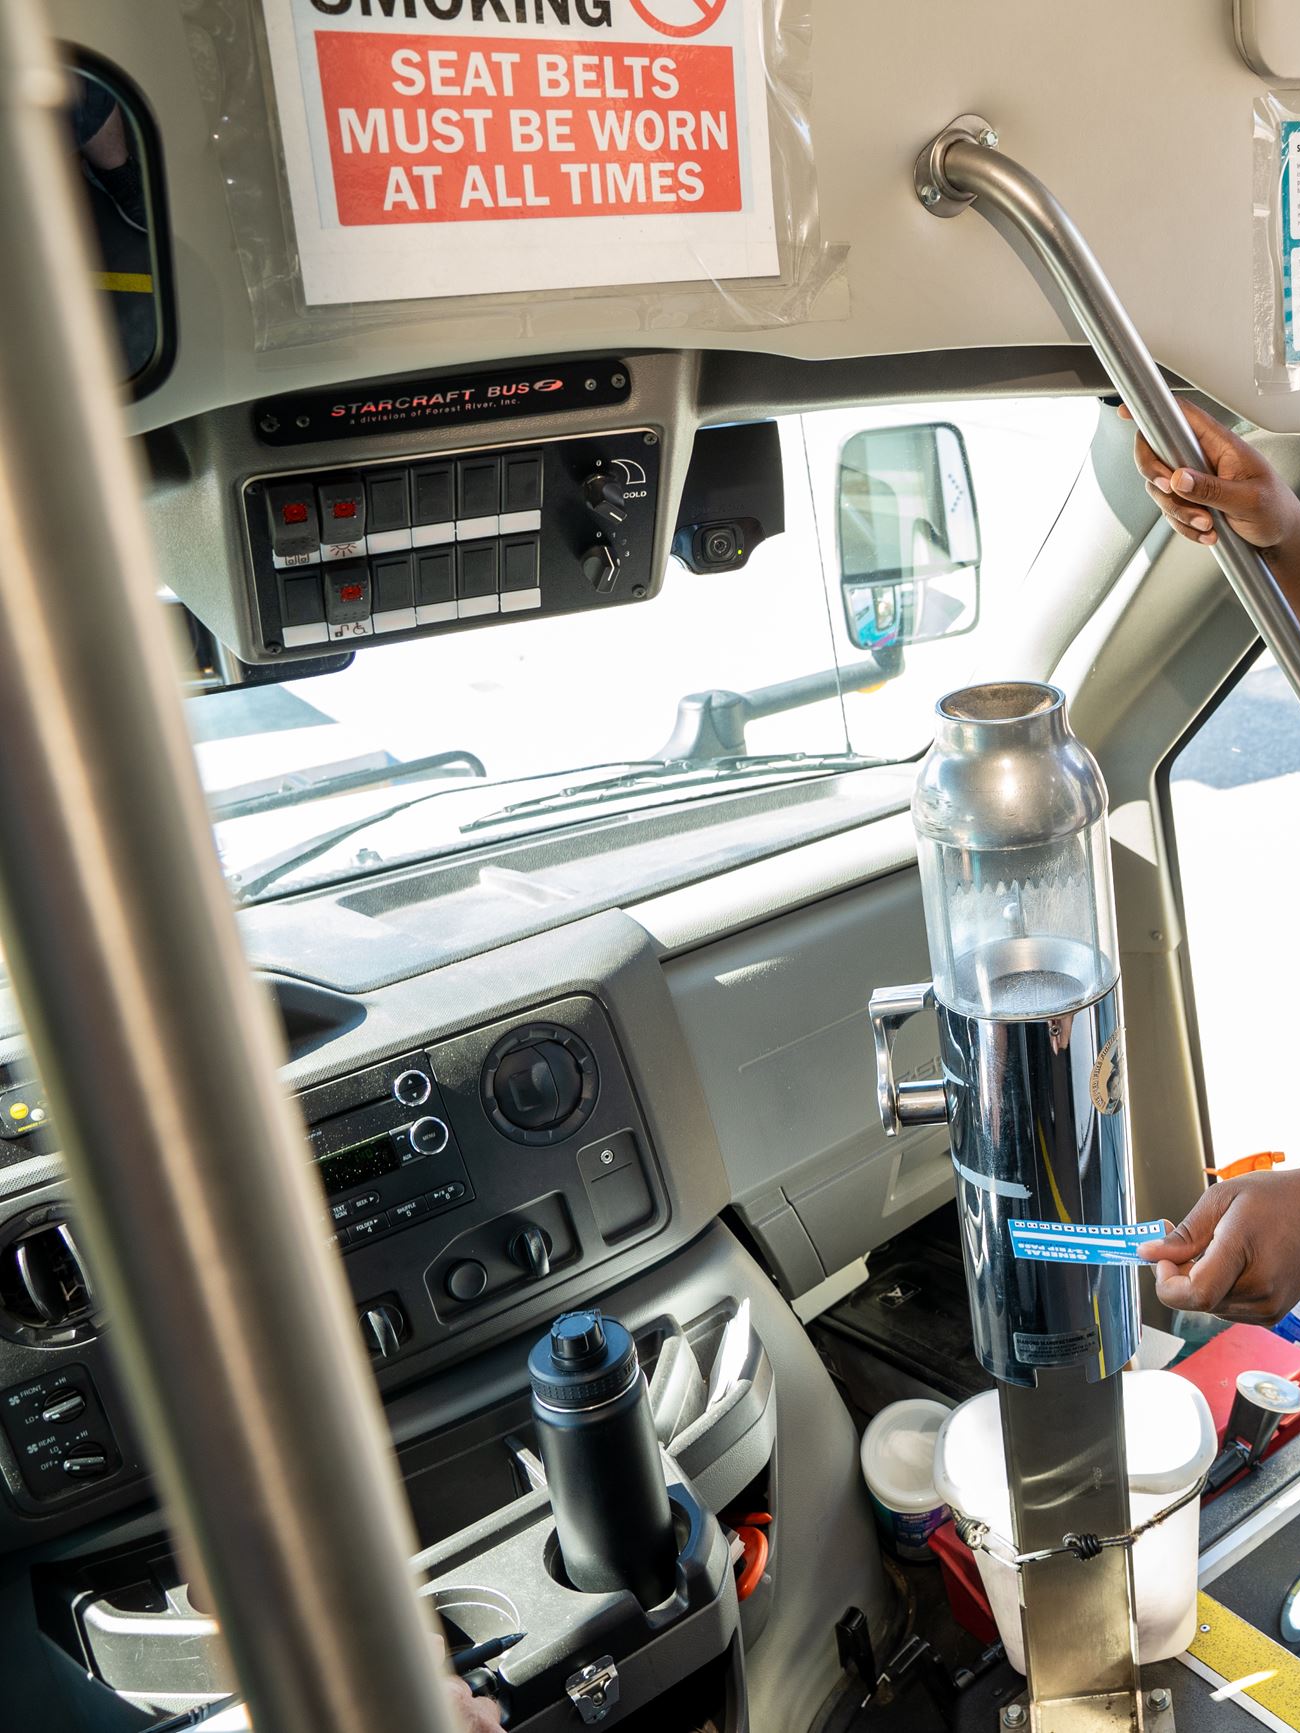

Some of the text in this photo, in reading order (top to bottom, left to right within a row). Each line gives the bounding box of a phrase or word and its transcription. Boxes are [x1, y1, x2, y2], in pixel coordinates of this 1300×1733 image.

[310, 0, 612, 27] KING
[390, 48, 680, 99] SEAT BELTS
[338, 108, 729, 154] MUST BE WORN
[383, 161, 705, 211] AT ALL TIMES
[330, 382, 530, 417] STARCRAFT BUS
[360, 411, 406, 424] division
[410, 409, 422, 417] of
[426, 405, 461, 415] Forest
[465, 400, 497, 410] River,
[500, 398, 521, 406] Inc.
[623, 491, 647, 499] COLD
[422, 1132, 436, 1141] MENU
[332, 1204, 345, 1213] TEXT
[397, 1202, 416, 1215] SHUFFLE
[334, 1211, 348, 1220] SCAN
[356, 1220, 374, 1232] FOLDER
[1024, 1249, 1087, 1260] GENERAL
[20, 1384, 42, 1398] FRONT
[25, 1416, 35, 1424] LO
[38, 1436, 56, 1447] REAR
[49, 1446, 59, 1454] LO
[40, 1462, 53, 1471] OFF
